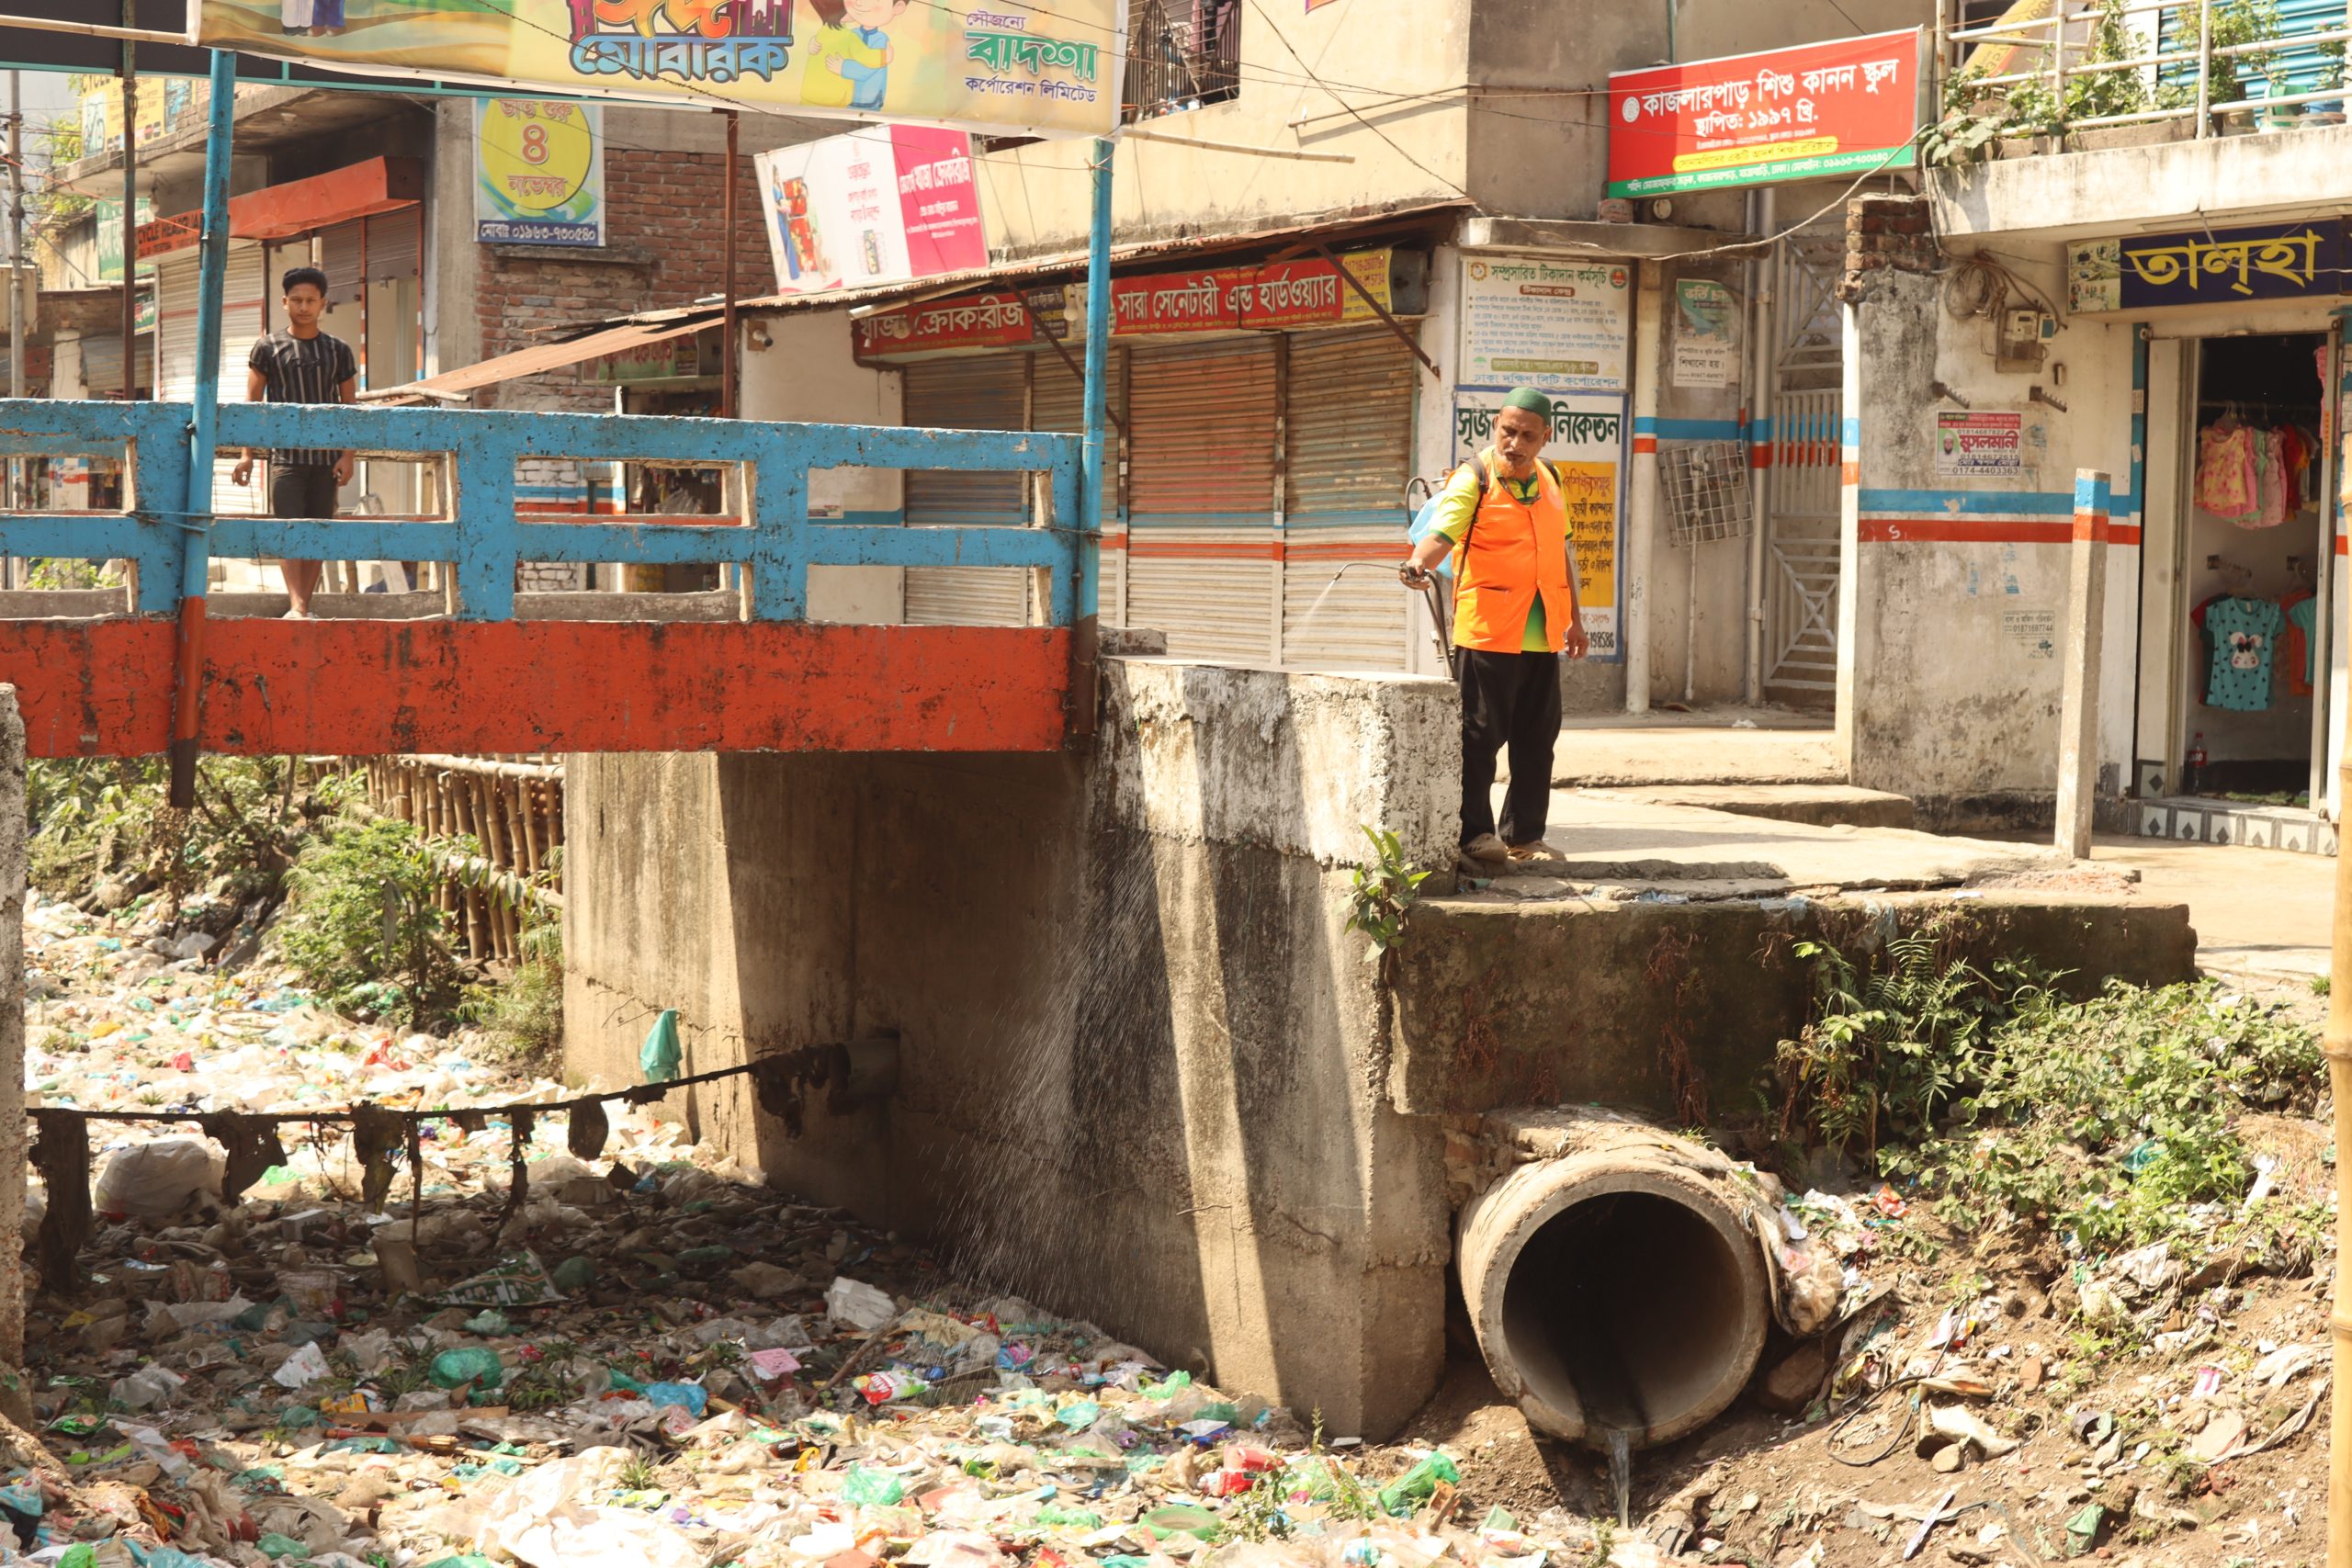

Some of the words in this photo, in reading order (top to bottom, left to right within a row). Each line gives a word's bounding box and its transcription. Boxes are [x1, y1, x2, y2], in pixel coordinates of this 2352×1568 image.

[967, 9, 1026, 31] সৌজন্যে
[965, 30, 1100, 83] বাদশা
[965, 74, 1035, 96] কর্পোরেশন
[1040, 79, 1097, 103] লিমিটেড
[1642, 80, 1752, 117] কাজলারপাড়
[1756, 68, 1794, 102] শিশু
[1801, 64, 1857, 96] কানন
[1860, 58, 1900, 95] স্কুল
[1748, 107, 1792, 129] ১৯৯৭
[522, 125, 549, 165] ৪
[506, 175, 569, 198] নভেম্বর
[1540, 263, 1574, 282] টিকাদান
[1117, 290, 1149, 321] সারা
[1152, 275, 1221, 320] সেনেটারী
[913, 295, 1025, 336] ক্রোকারীজ
